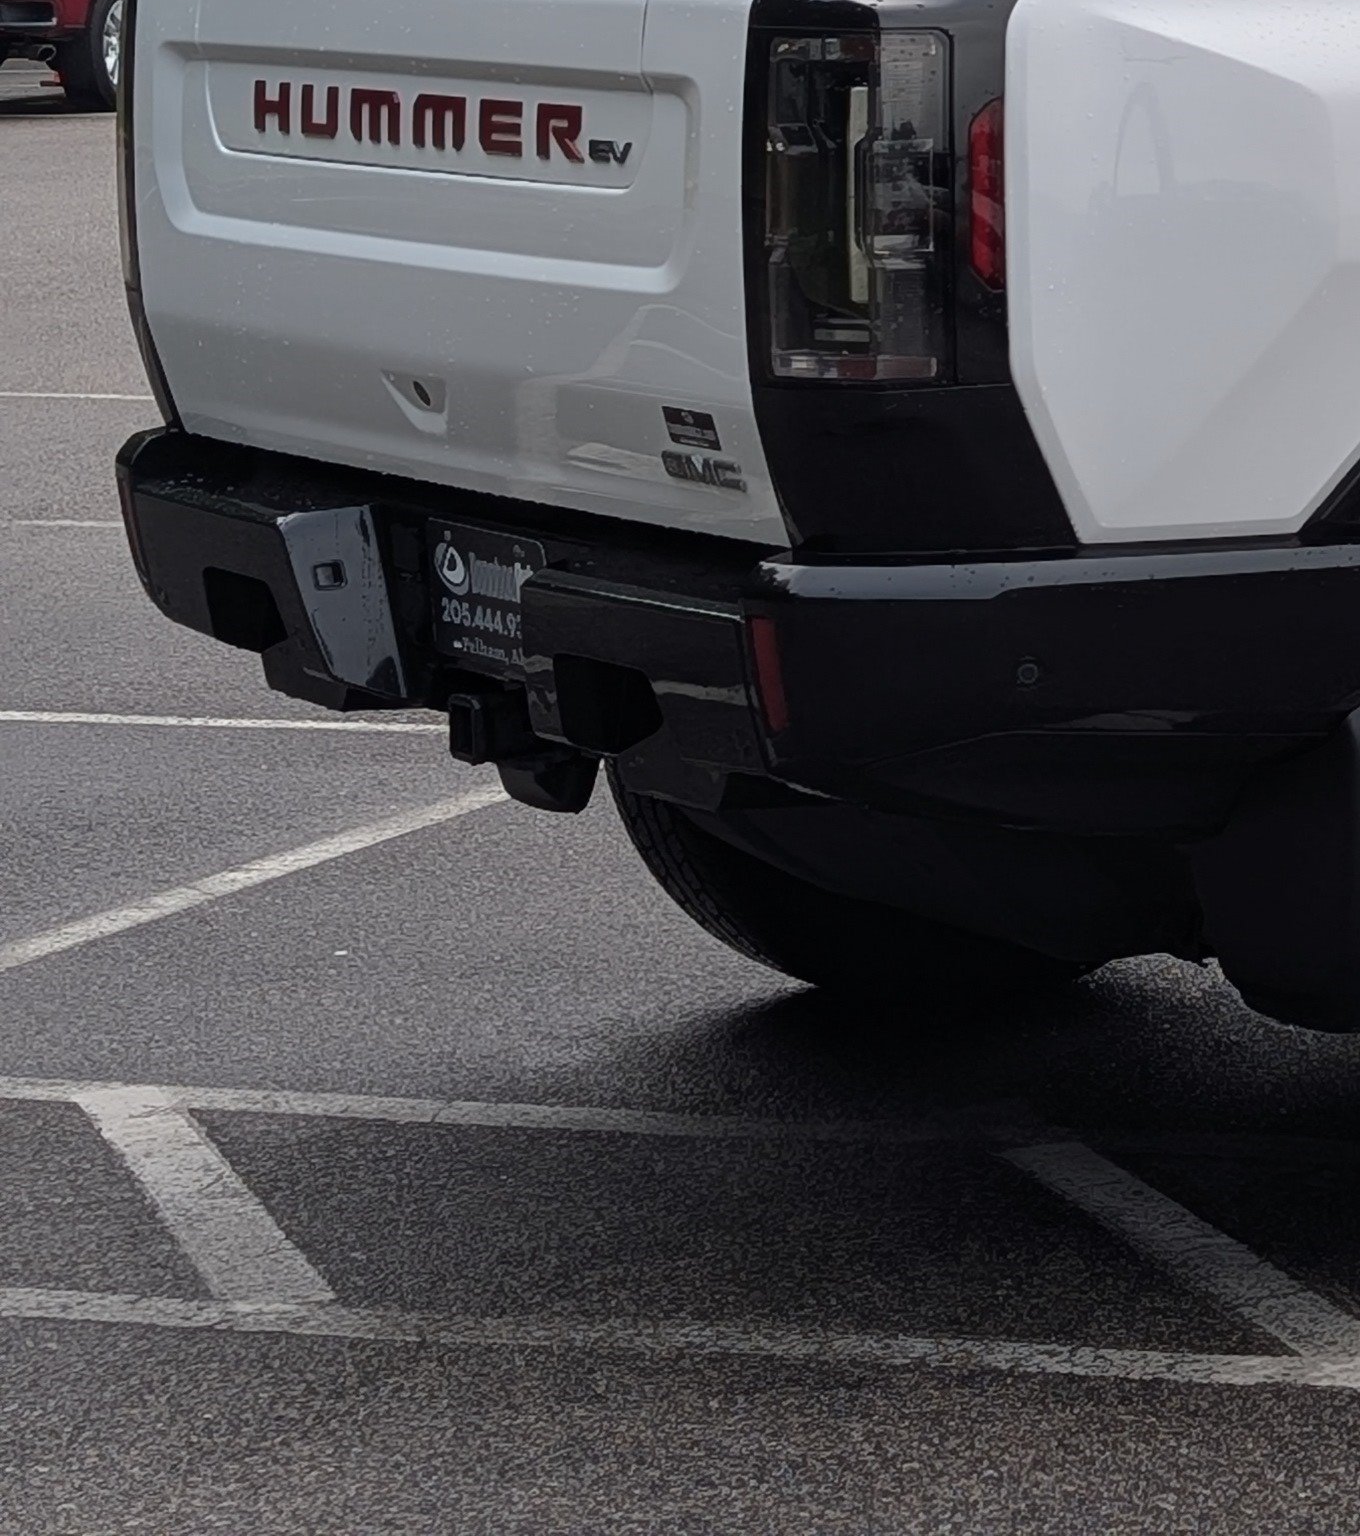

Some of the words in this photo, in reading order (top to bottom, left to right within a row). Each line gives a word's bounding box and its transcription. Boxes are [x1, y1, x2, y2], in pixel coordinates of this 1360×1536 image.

[254, 80, 585, 163] HUMMER
[588, 139, 633, 165] EV
[661, 450, 747, 493] GMC
